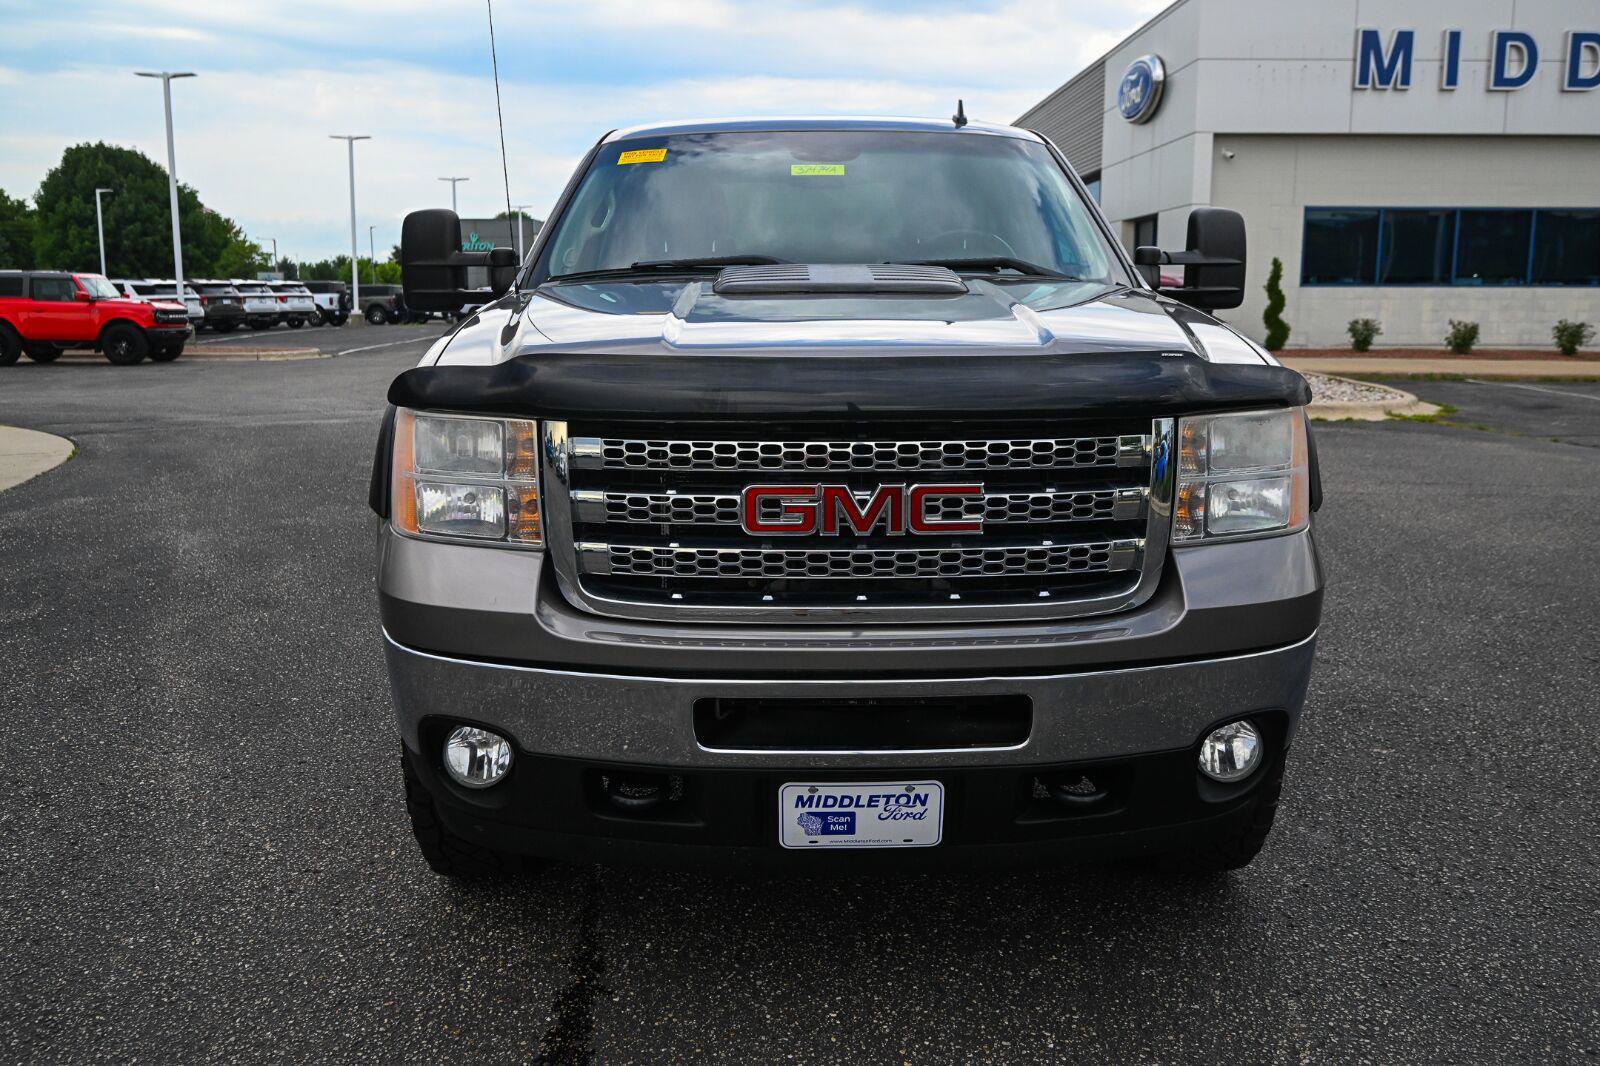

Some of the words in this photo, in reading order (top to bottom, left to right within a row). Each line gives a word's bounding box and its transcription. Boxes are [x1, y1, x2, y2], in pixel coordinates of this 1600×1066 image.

[741, 482, 985, 536] GMC
[794, 793, 930, 809] MIDDLETON
[827, 815, 851, 823] Scan
[877, 803, 929, 821] Ford
